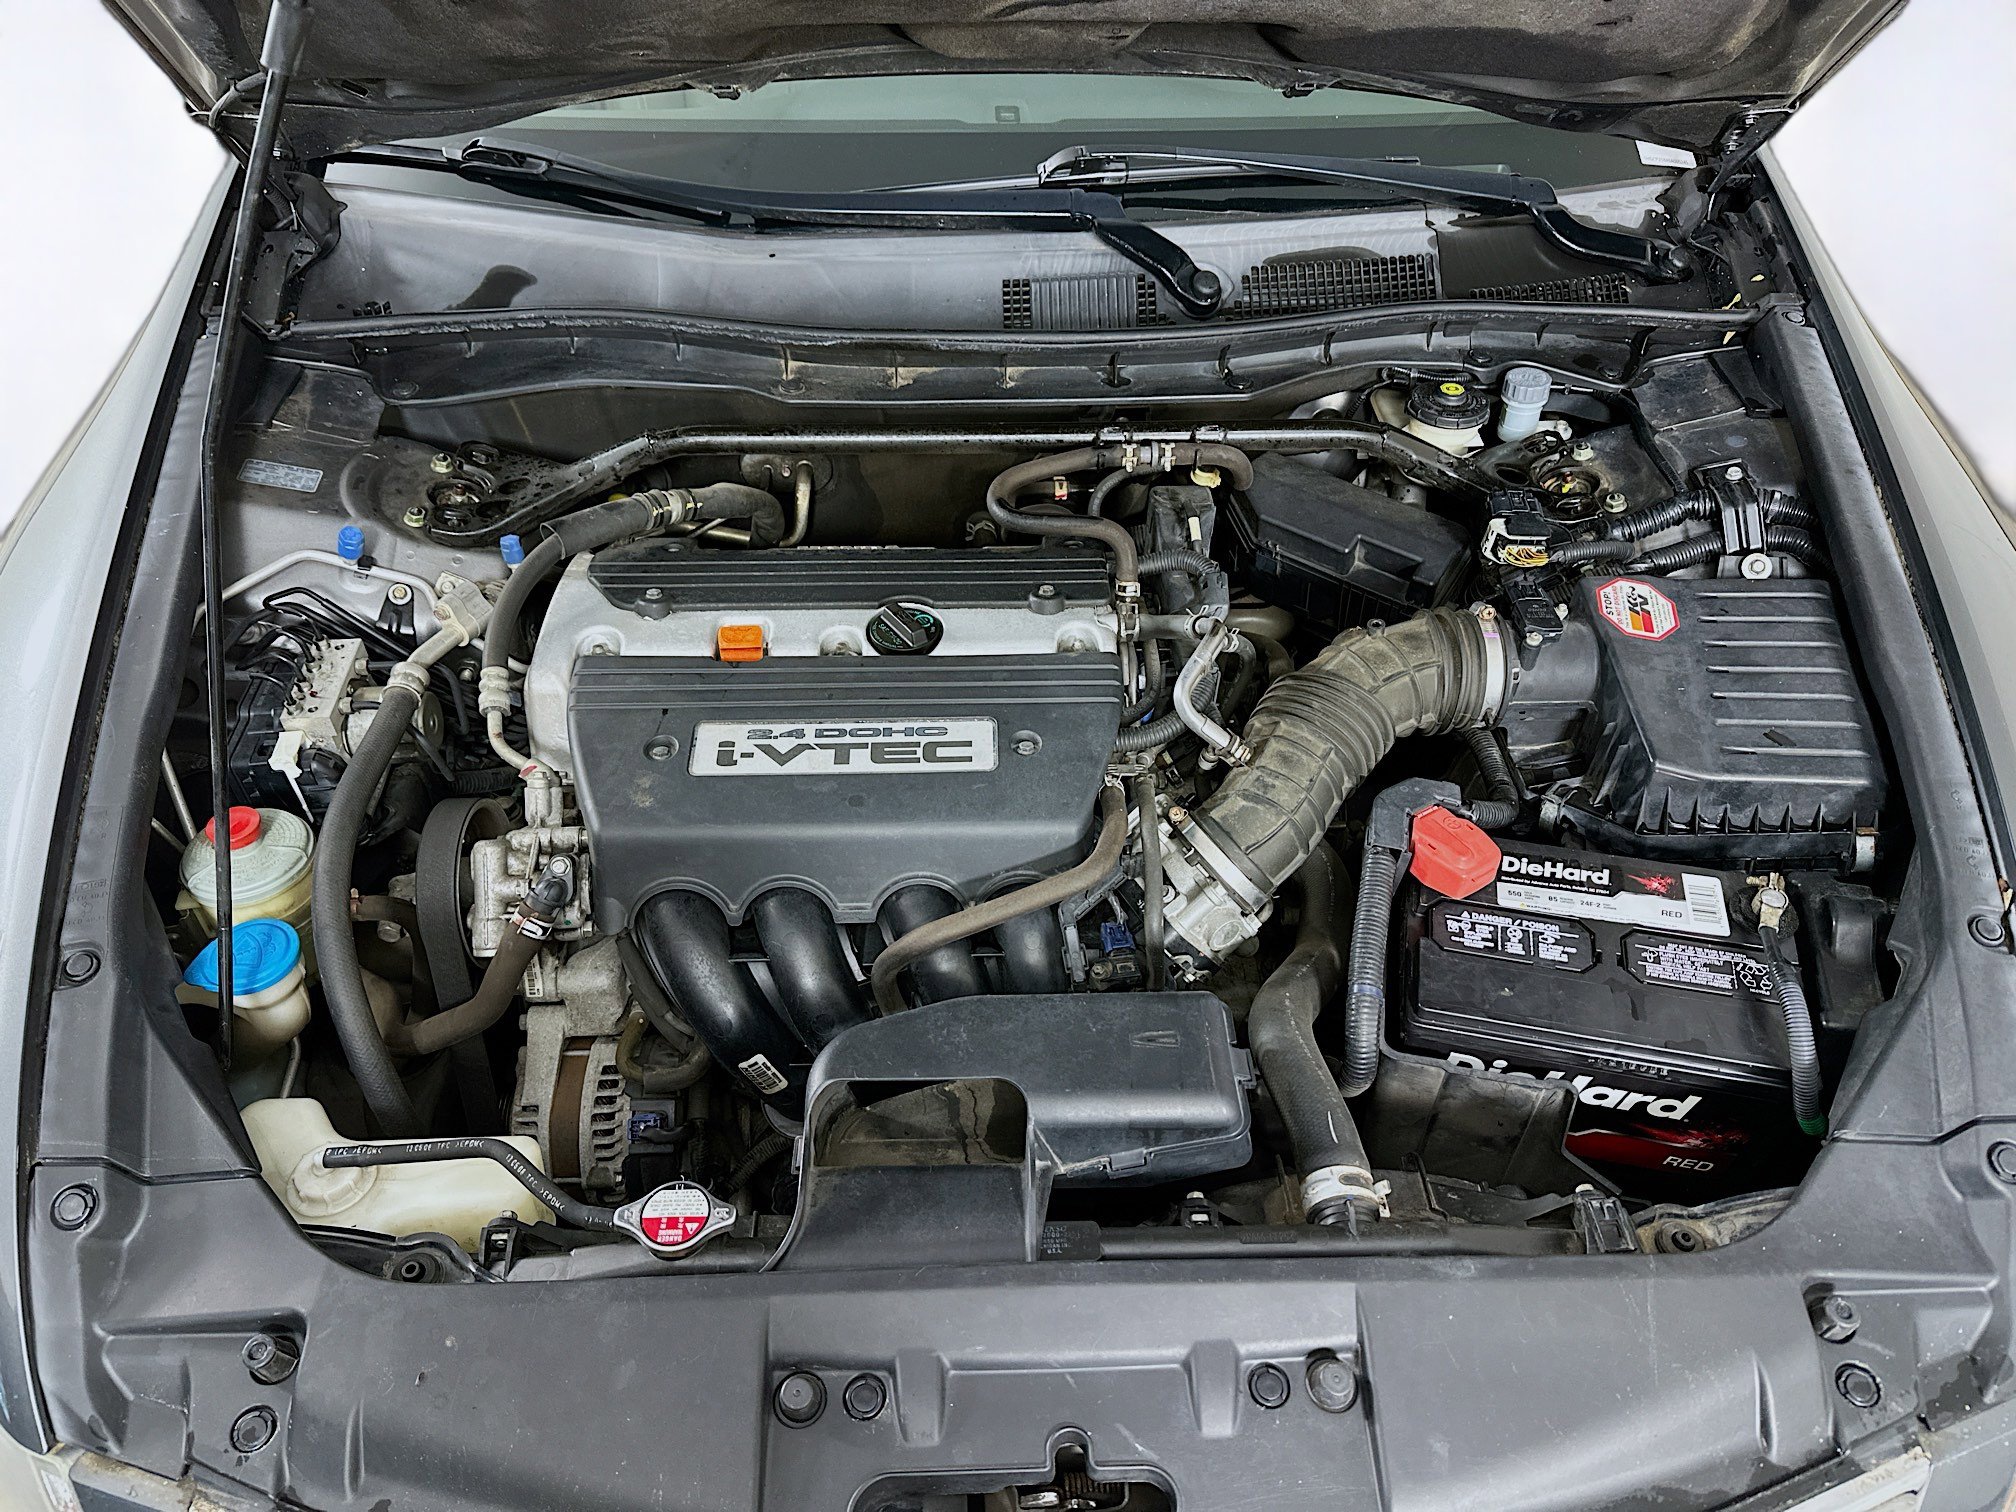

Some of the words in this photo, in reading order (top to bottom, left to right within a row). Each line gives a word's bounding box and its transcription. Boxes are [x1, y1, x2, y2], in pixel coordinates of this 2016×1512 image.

[747, 728, 805, 741] 2.4
[814, 726, 949, 738] DOHC
[716, 740, 974, 768] i-VTEC
[1501, 855, 1611, 886] DieHard
[1661, 909, 1683, 919] RED
[1663, 1155, 1714, 1172] RED
